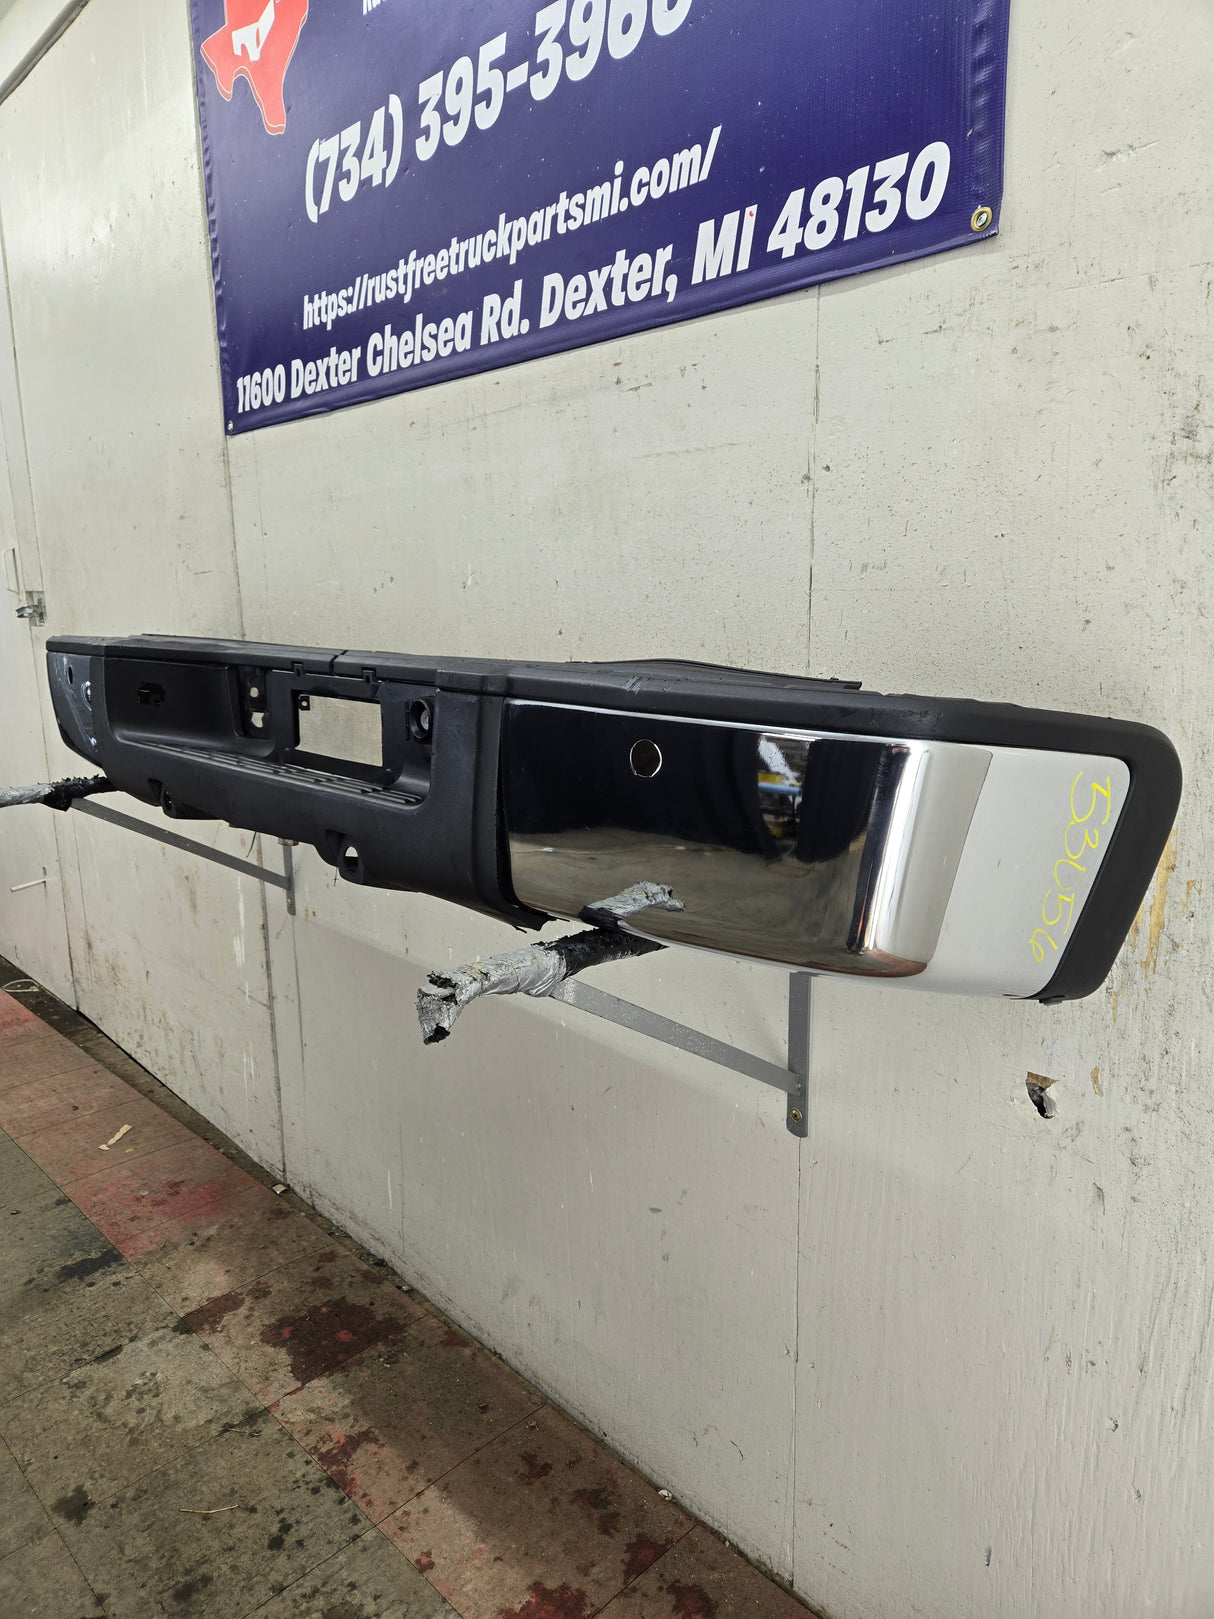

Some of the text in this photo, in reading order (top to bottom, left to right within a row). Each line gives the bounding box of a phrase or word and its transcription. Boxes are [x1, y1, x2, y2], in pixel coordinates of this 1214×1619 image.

[303, 125, 723, 331] https://rustfreetruckpartsmi.com/
[304, 93, 404, 224] (734)
[236, 141, 951, 414] 11600 Dexter Chelsea Rd. Dexter, MI 48130
